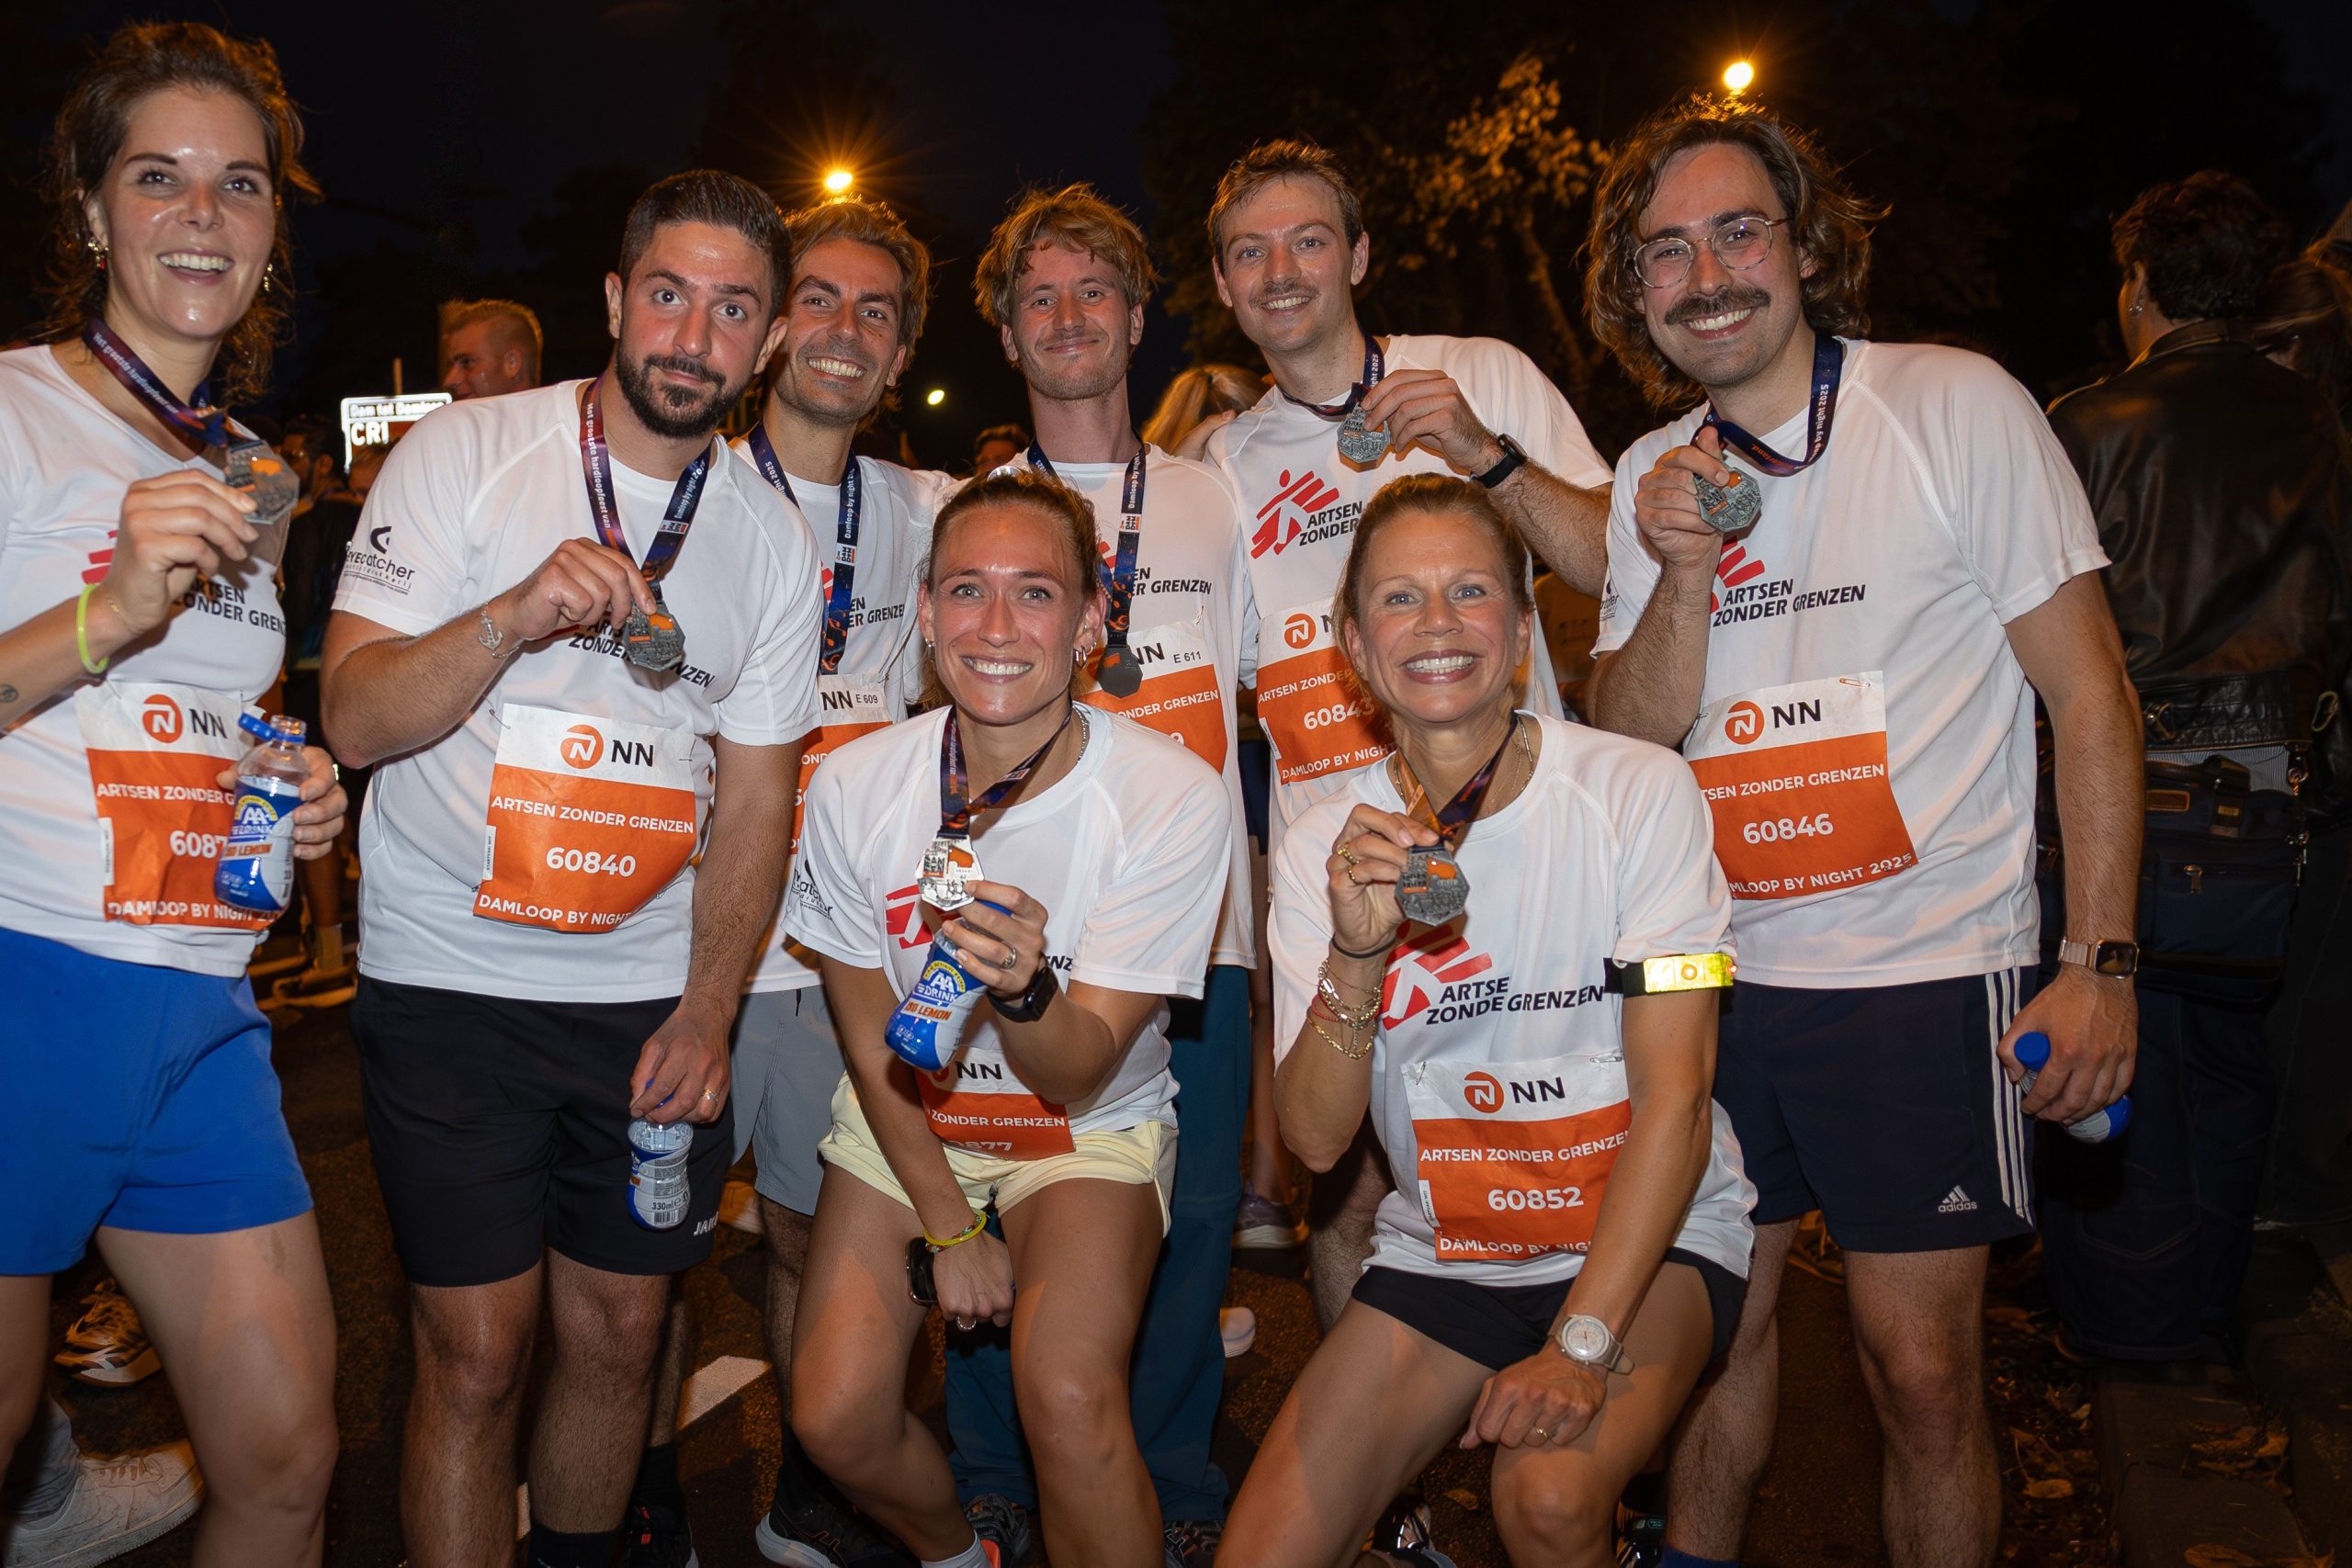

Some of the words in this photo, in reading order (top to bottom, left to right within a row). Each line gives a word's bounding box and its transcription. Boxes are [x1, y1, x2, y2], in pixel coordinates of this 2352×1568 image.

[1819, 384, 1829, 406] 2025
[1816, 407, 1826, 429] night
[765, 461, 777, 479] 2025
[1131, 470, 1139, 479] by
[847, 479, 855, 497] night
[1128, 479, 1139, 509] Damloop
[847, 496, 855, 509] by
[600, 514, 611, 529] van
[845, 507, 855, 539] Damloop
[1306, 501, 1363, 529] ARTSEN
[1151, 580, 1212, 595] GRENZEN
[1723, 579, 1793, 607] ARTSEN
[176, 592, 243, 622] ONDER
[248, 609, 286, 637] GREN
[1713, 600, 1787, 627] ZONDER
[1792, 585, 1866, 611] GRENZEN
[1173, 654, 1181, 663] E
[1184, 651, 1202, 662] 611
[820, 691, 854, 711] NN
[855, 694, 862, 703] E
[864, 694, 878, 705] 609
[1163, 689, 1219, 711] GRENZEN
[1258, 682, 1298, 705] ARTSEN
[188, 708, 228, 739] NN
[1771, 699, 1822, 729] NN
[611, 739, 654, 768] NN
[1282, 759, 1331, 780] DAMLOOP
[1333, 752, 1351, 767] BY
[1701, 786, 1736, 800] TSEN
[1739, 775, 1804, 796] ZONDER
[1807, 763, 1885, 786] GRENZEN
[96, 784, 160, 800] ARTSEN
[163, 786, 224, 805] ZONDER
[243, 807, 269, 825] AA
[492, 795, 556, 818] ARTSEN
[559, 805, 626, 828] ZONDER
[628, 815, 695, 835] GRENZEN
[1743, 813, 1834, 845] 60846
[169, 829, 229, 859] 6087
[546, 846, 636, 878] 60840
[1784, 877, 1804, 891] BY
[1810, 866, 1864, 888] NIGHT
[190, 903, 211, 919] BY
[478, 895, 563, 922] DAMLOOP
[567, 910, 588, 925] BY
[930, 972, 955, 994] AA
[1507, 985, 1605, 1012] GRENZEN
[918, 1005, 953, 1021] LEMON
[955, 1061, 1003, 1080] NN
[1510, 1077, 1566, 1104] NN
[931, 1109, 989, 1127] ZONDER
[993, 1117, 1066, 1128] GRENZEN
[1420, 1148, 1483, 1163] ARTSEN
[1487, 1148, 1555, 1163] ZONDER
[1557, 1130, 1629, 1161] GRENZE
[1487, 1186, 1584, 1212] 60852
[1938, 1200, 1978, 1213] adidas
[1440, 1237, 1524, 1255] DAMLOOP
